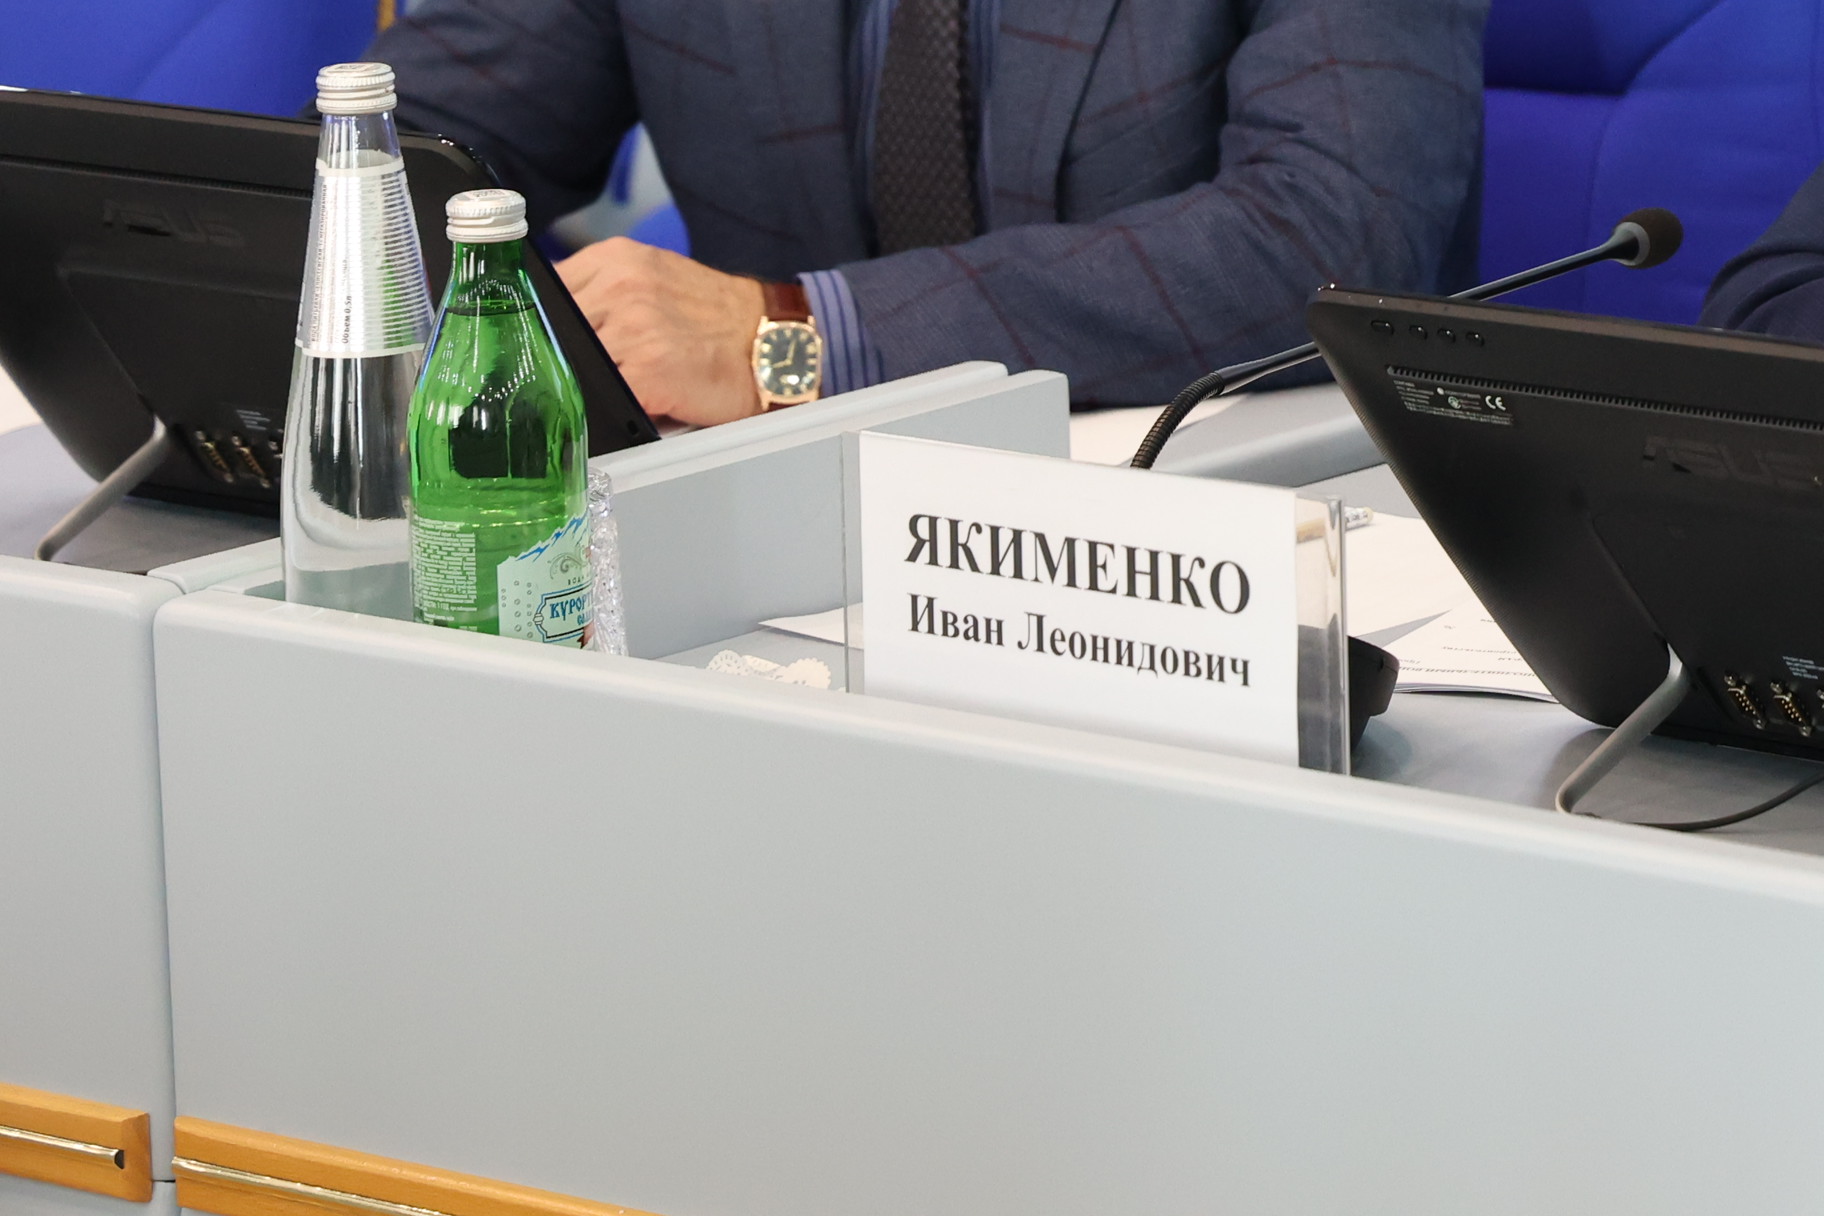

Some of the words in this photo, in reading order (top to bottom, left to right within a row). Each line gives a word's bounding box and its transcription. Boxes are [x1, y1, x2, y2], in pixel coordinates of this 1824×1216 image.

[904, 513, 1251, 615] ЯКИМЕНКО
[908, 593, 1005, 647] Иван
[1017, 612, 1251, 688] Леонидович
